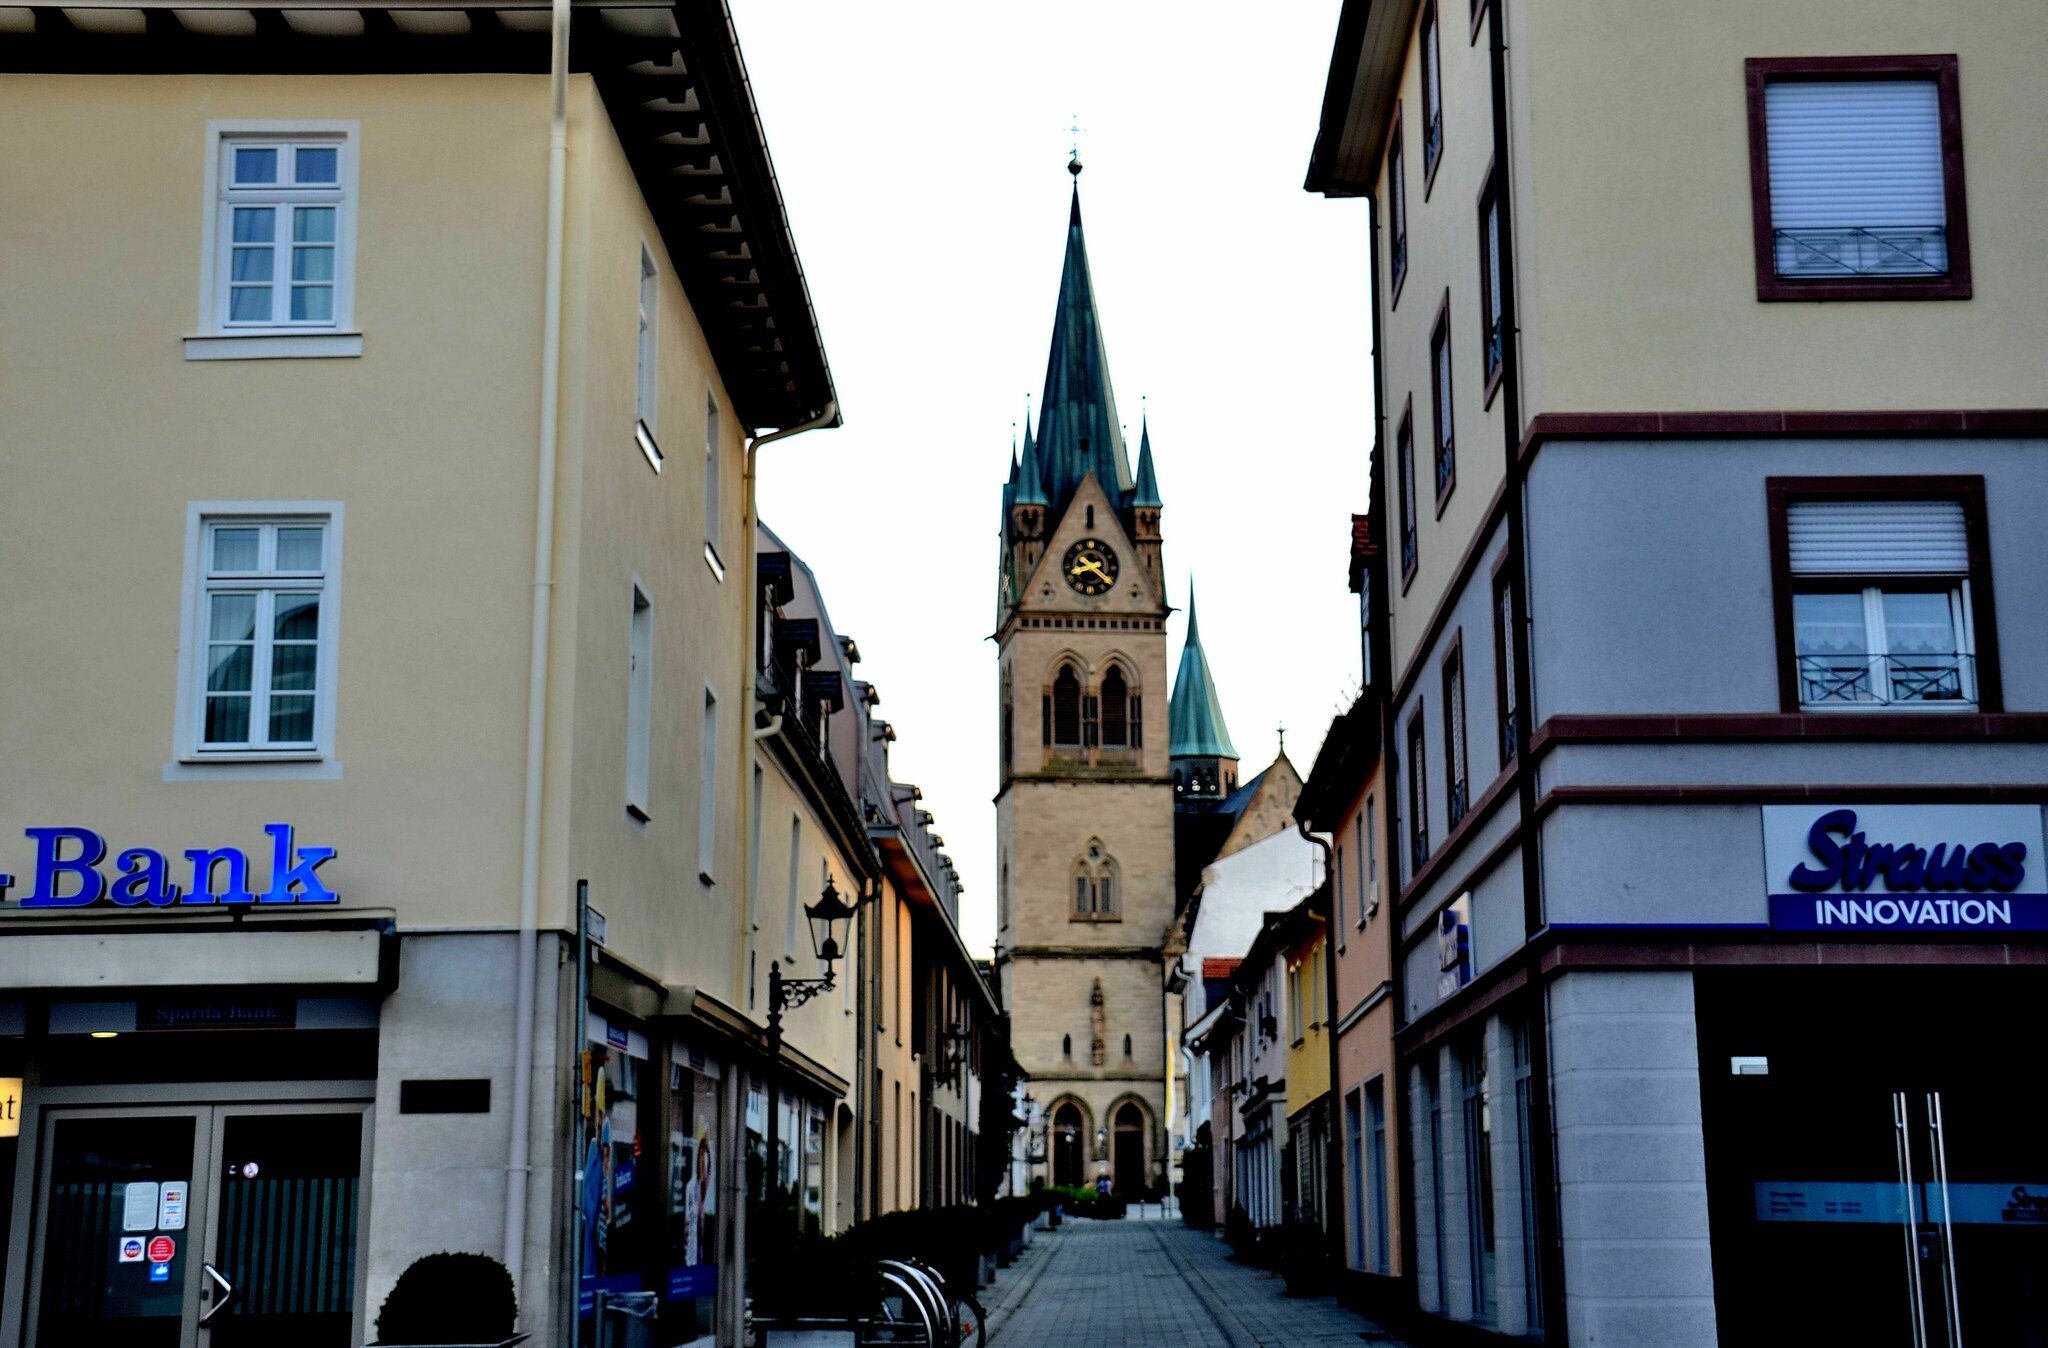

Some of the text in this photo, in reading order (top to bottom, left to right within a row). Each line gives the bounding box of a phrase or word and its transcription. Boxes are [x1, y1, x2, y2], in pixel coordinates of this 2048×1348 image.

[1788, 809, 2027, 892] Strauss
[1815, 900, 2012, 925] INNOVATION
[155, 1003, 279, 1023] Sparda-Bank
